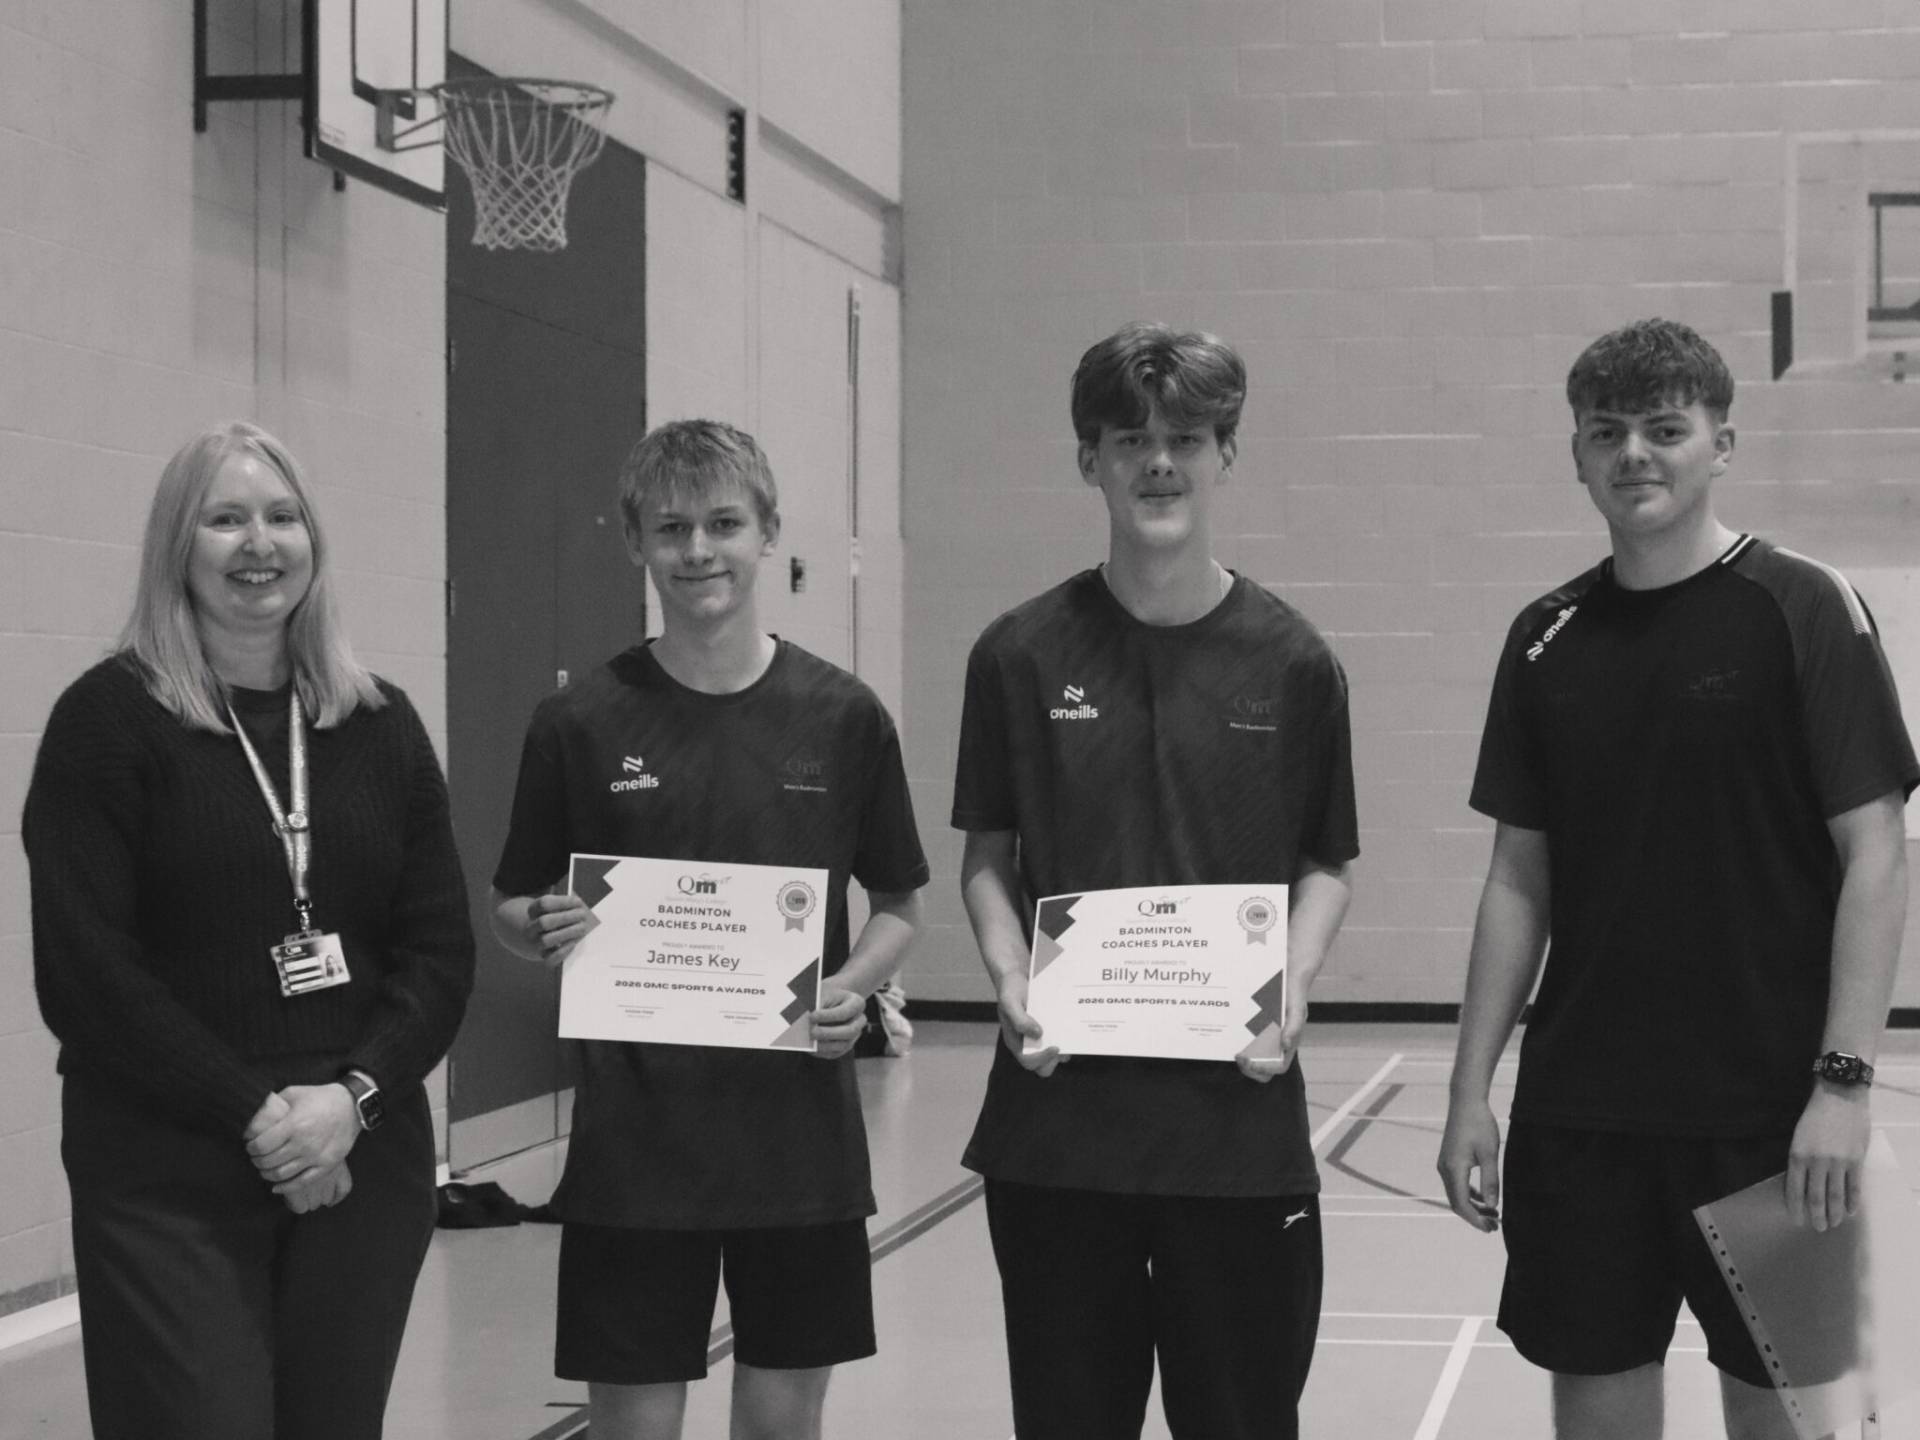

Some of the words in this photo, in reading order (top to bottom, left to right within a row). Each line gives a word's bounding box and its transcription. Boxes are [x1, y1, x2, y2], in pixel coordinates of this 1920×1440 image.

[677, 875, 717, 896] Qm
[658, 904, 731, 918] BADMINTON
[1138, 899, 1176, 917] Qm
[640, 918, 697, 931] COACHES
[701, 921, 747, 933] PLAYER
[1119, 926, 1192, 935] BADMINTON
[1101, 940, 1159, 949] COACHES
[1162, 939, 1208, 948] PLAYER
[647, 950, 703, 967] James
[708, 953, 740, 971] Key
[1101, 968, 1138, 984] Billy
[1144, 968, 1212, 985] Murphy
[615, 980, 641, 988] 2026
[671, 983, 714, 993] SPORTS
[716, 985, 766, 996] AWARDS
[1179, 999, 1230, 1007] AWARDS
